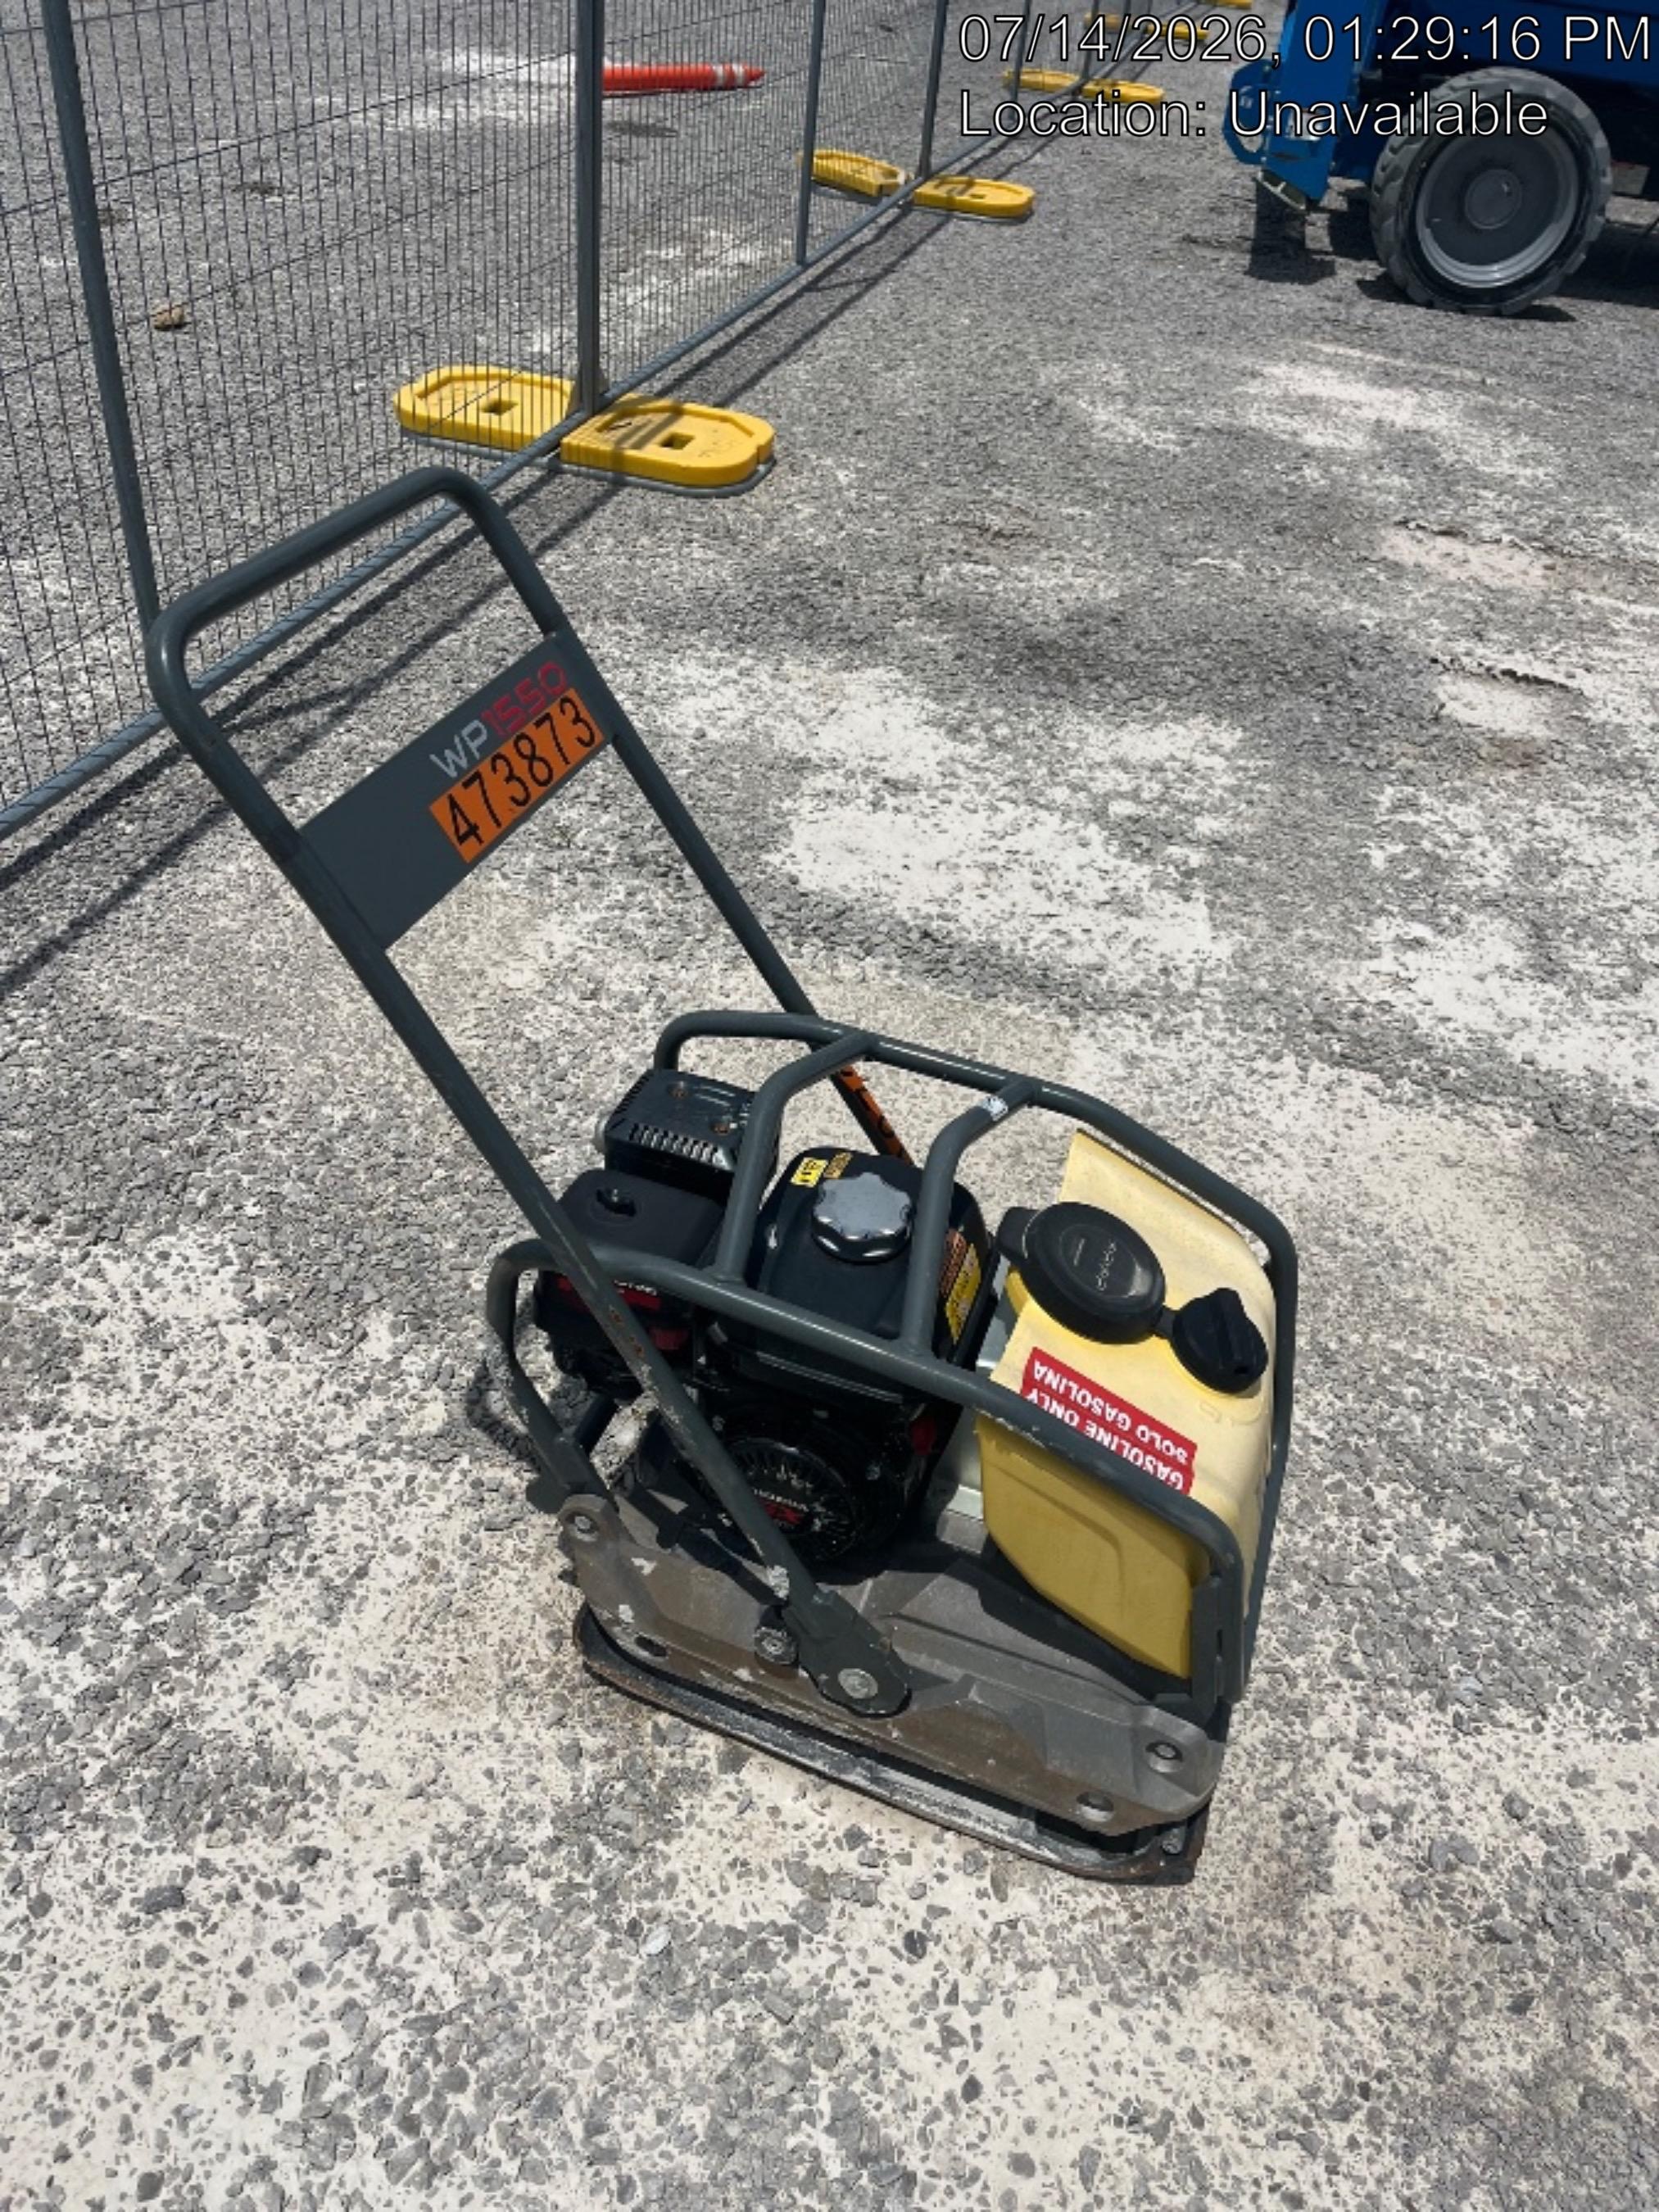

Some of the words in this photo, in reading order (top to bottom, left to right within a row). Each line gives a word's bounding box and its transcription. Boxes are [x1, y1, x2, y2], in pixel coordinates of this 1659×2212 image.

[429, 660, 568, 779] WP1550
[446, 696, 596, 846] 473873
[1026, 1388, 1080, 1427] ONLY
[1034, 1359, 1131, 1431] GASOLINA
[1085, 1419, 1185, 1490] GASOLINE
[1135, 1425, 1188, 1465] SOLO
